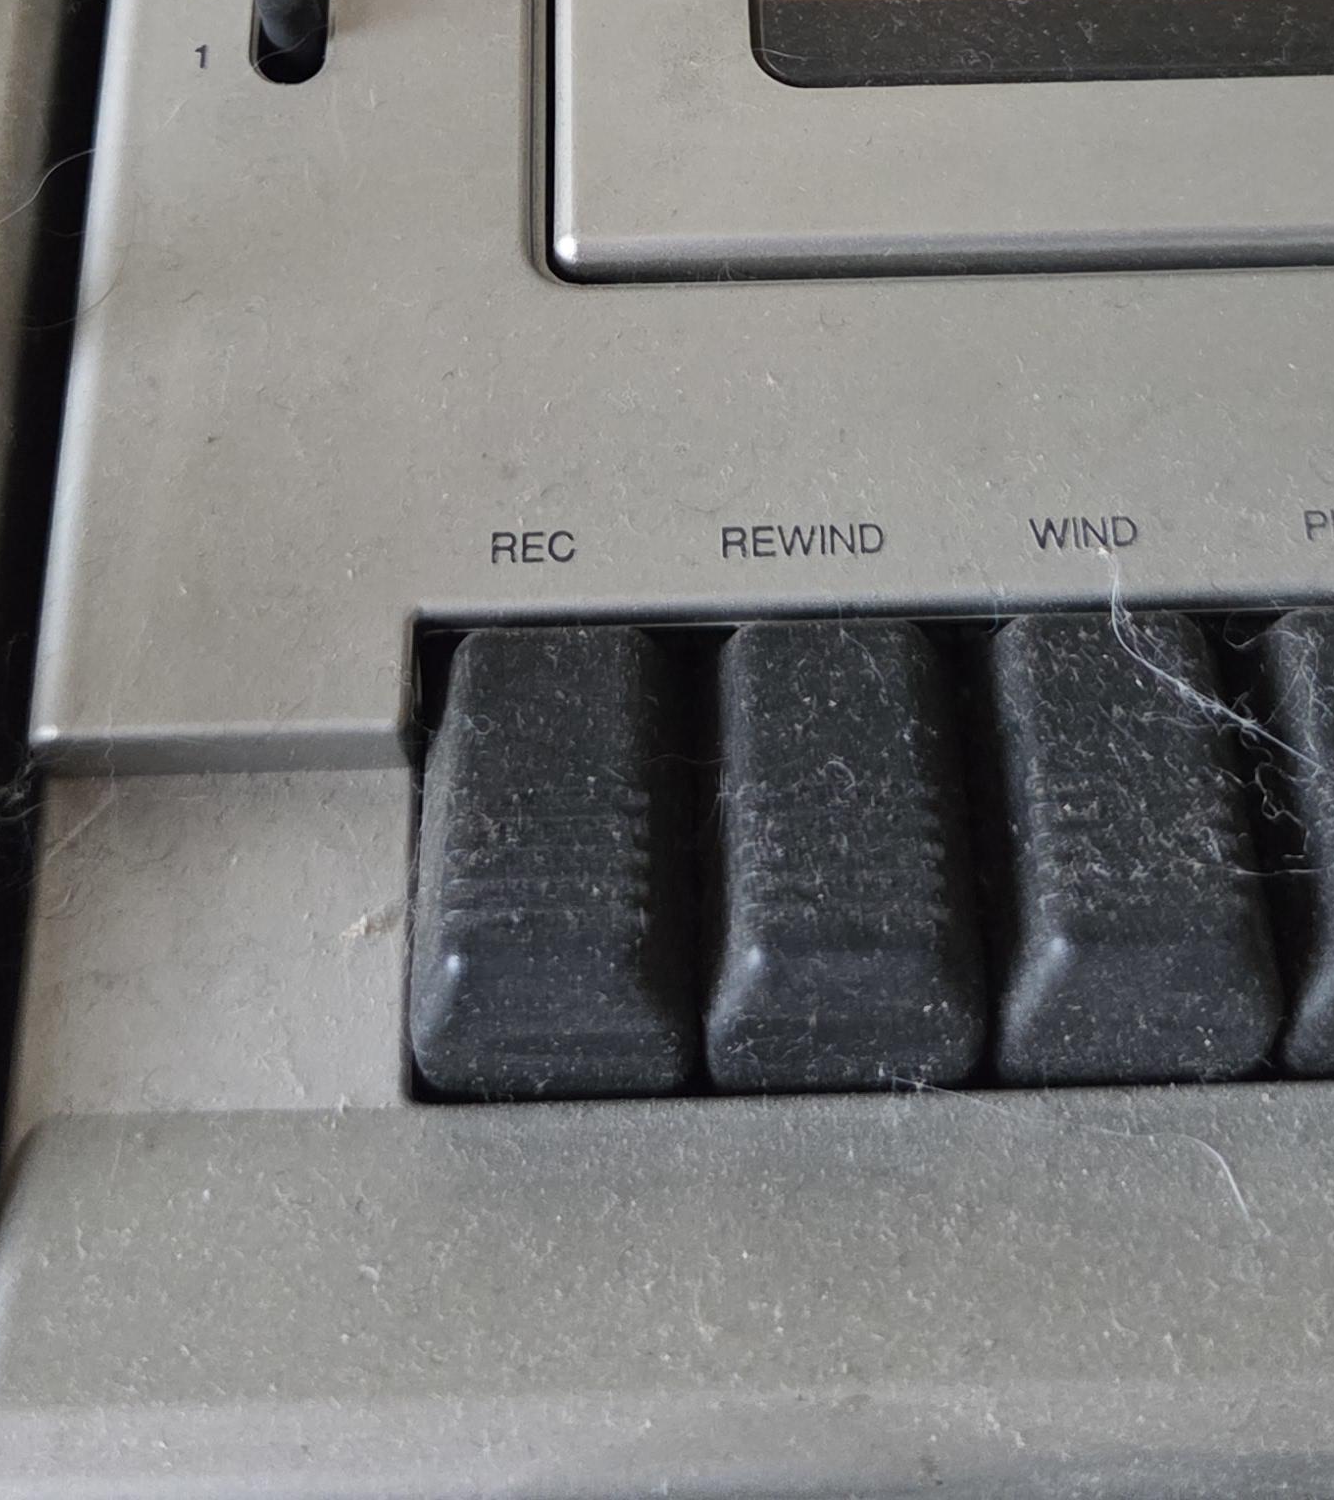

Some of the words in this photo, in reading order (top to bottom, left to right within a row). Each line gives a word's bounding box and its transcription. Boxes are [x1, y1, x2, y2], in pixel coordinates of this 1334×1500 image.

[194, 44, 208, 69] 1
[490, 531, 577, 565] REC
[721, 521, 886, 560] REWIND
[1029, 514, 1139, 551] WIND
